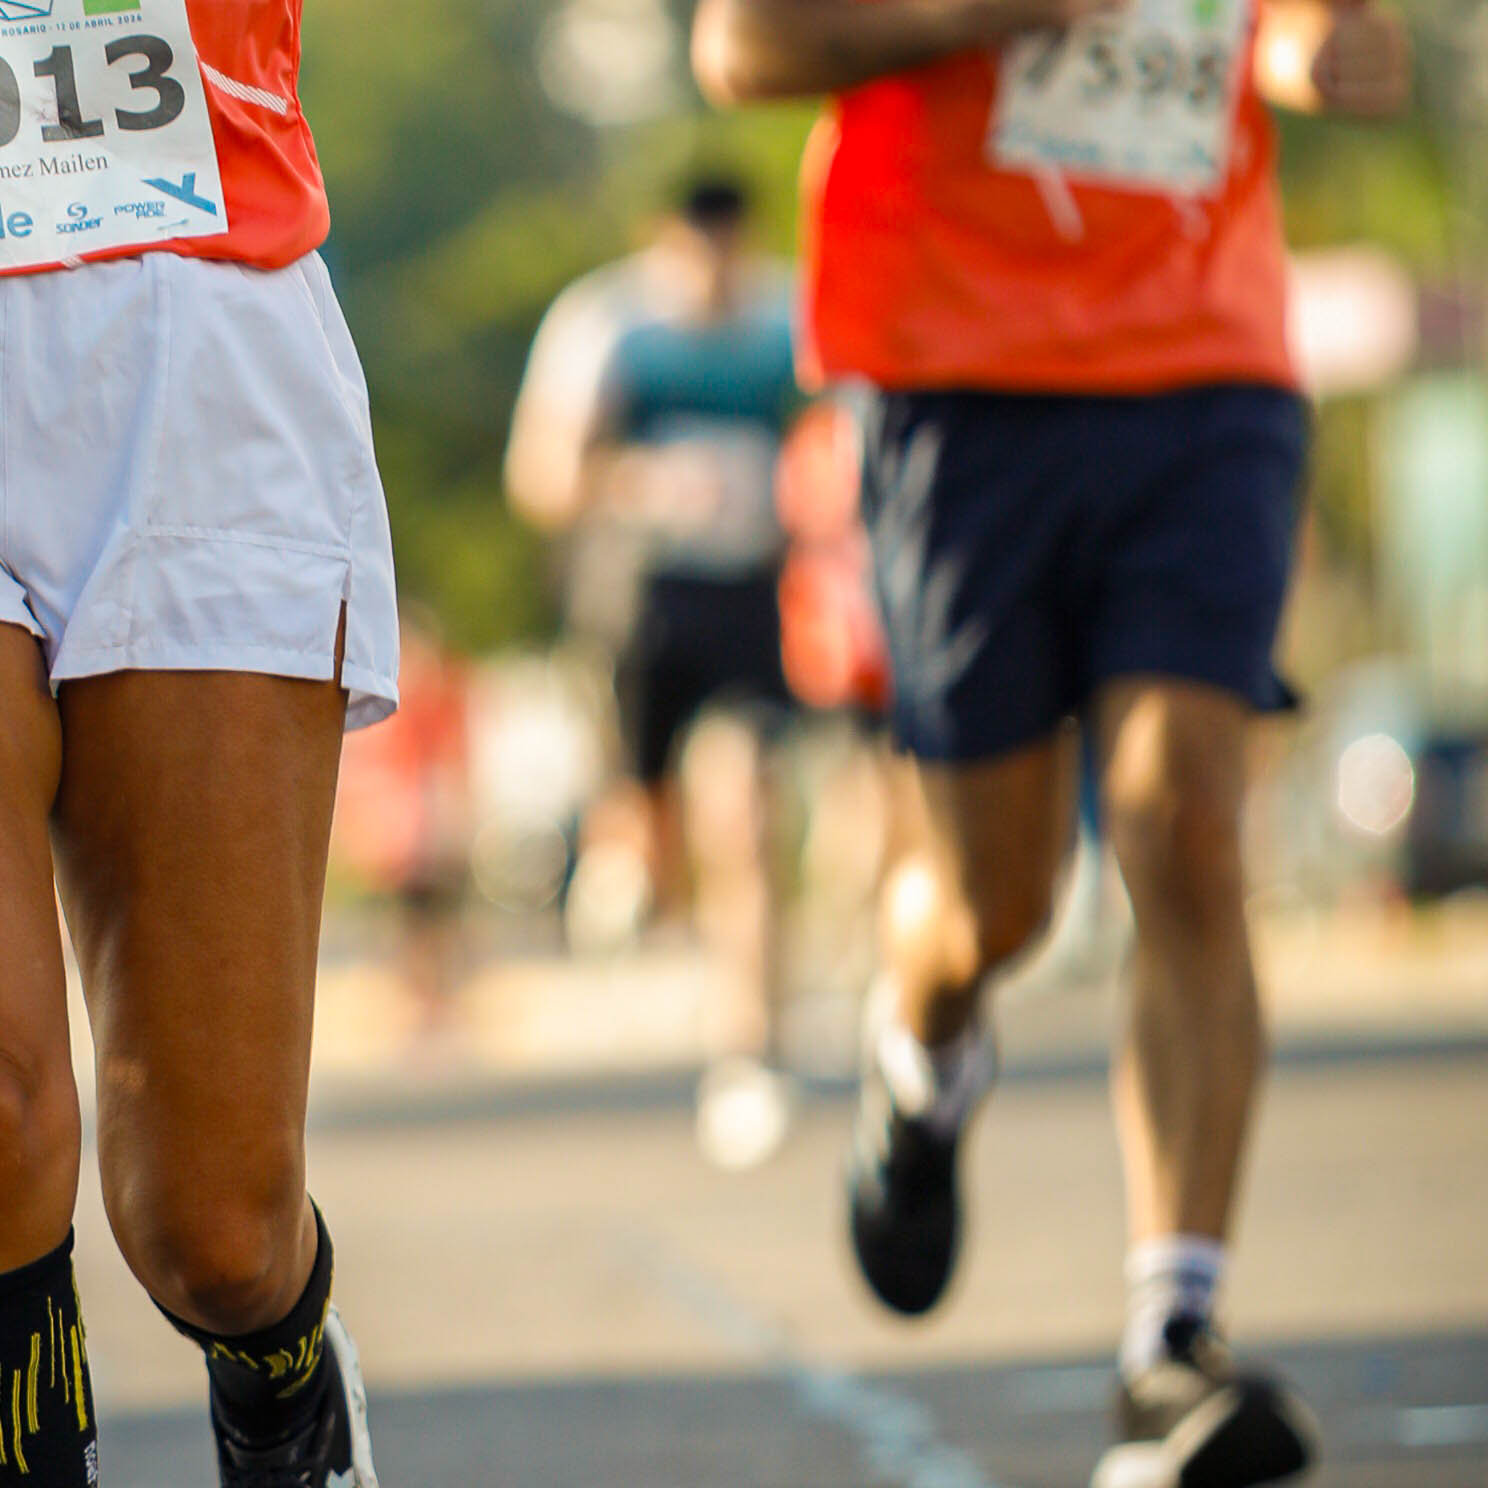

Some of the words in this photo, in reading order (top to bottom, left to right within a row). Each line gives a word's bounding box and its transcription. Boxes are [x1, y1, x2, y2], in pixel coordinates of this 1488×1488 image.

[1, 24, 47, 37] ROSARIO
[56, 22, 66, 32] 12
[69, 21, 81, 30] DE
[84, 18, 114, 29] ABRIL
[118, 13, 143, 25] 2026
[39, 154, 109, 177] Mailen
